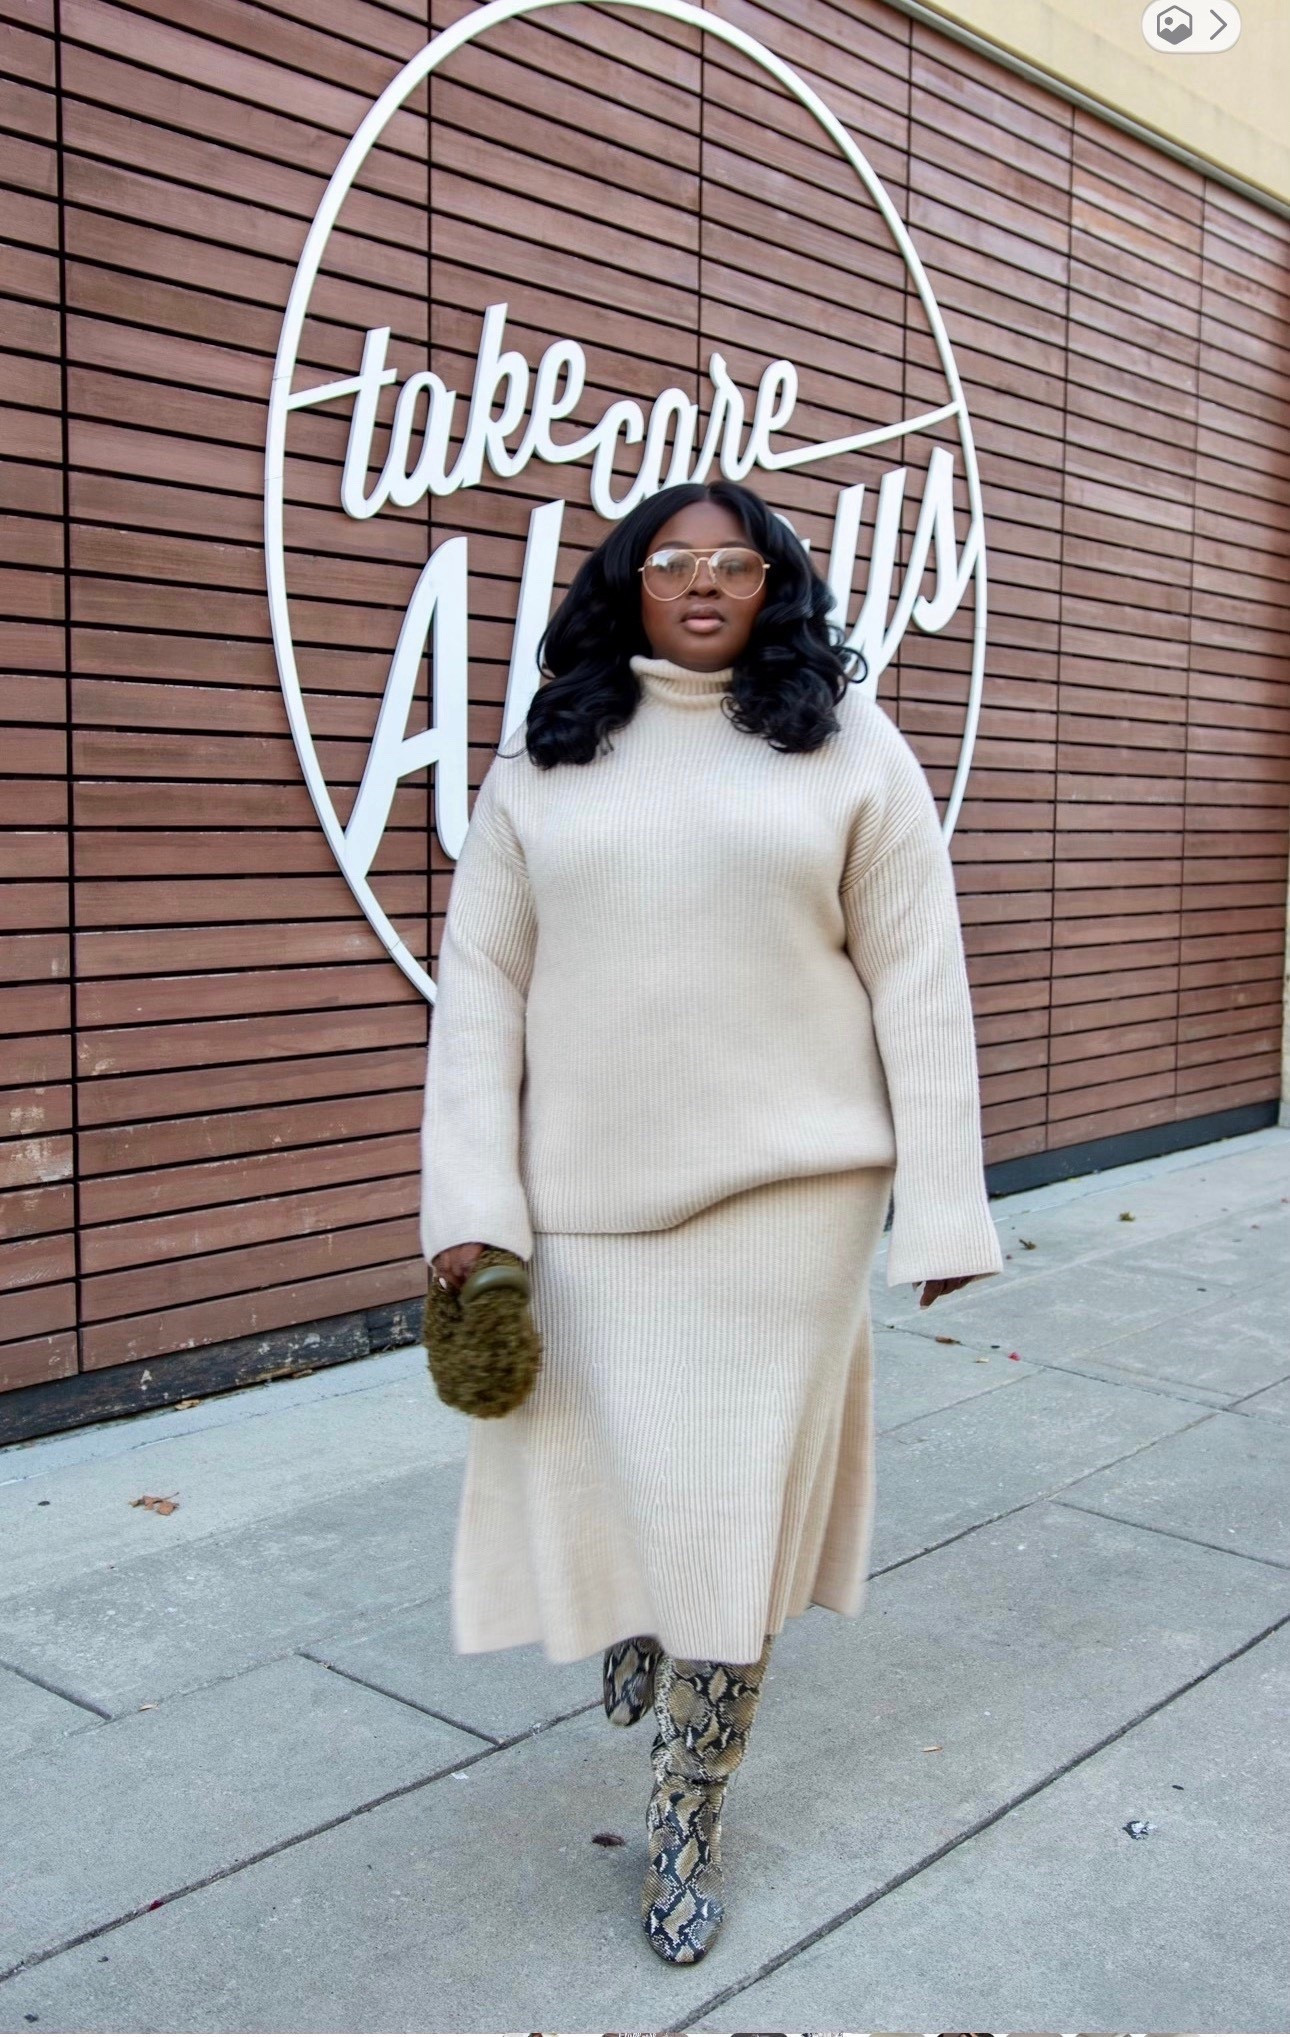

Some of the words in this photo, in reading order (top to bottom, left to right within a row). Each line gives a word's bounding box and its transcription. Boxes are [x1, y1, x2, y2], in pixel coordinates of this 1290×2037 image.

[287, 303, 597, 520] take
[591, 353, 963, 520] care
[344, 446, 984, 878] Alys
